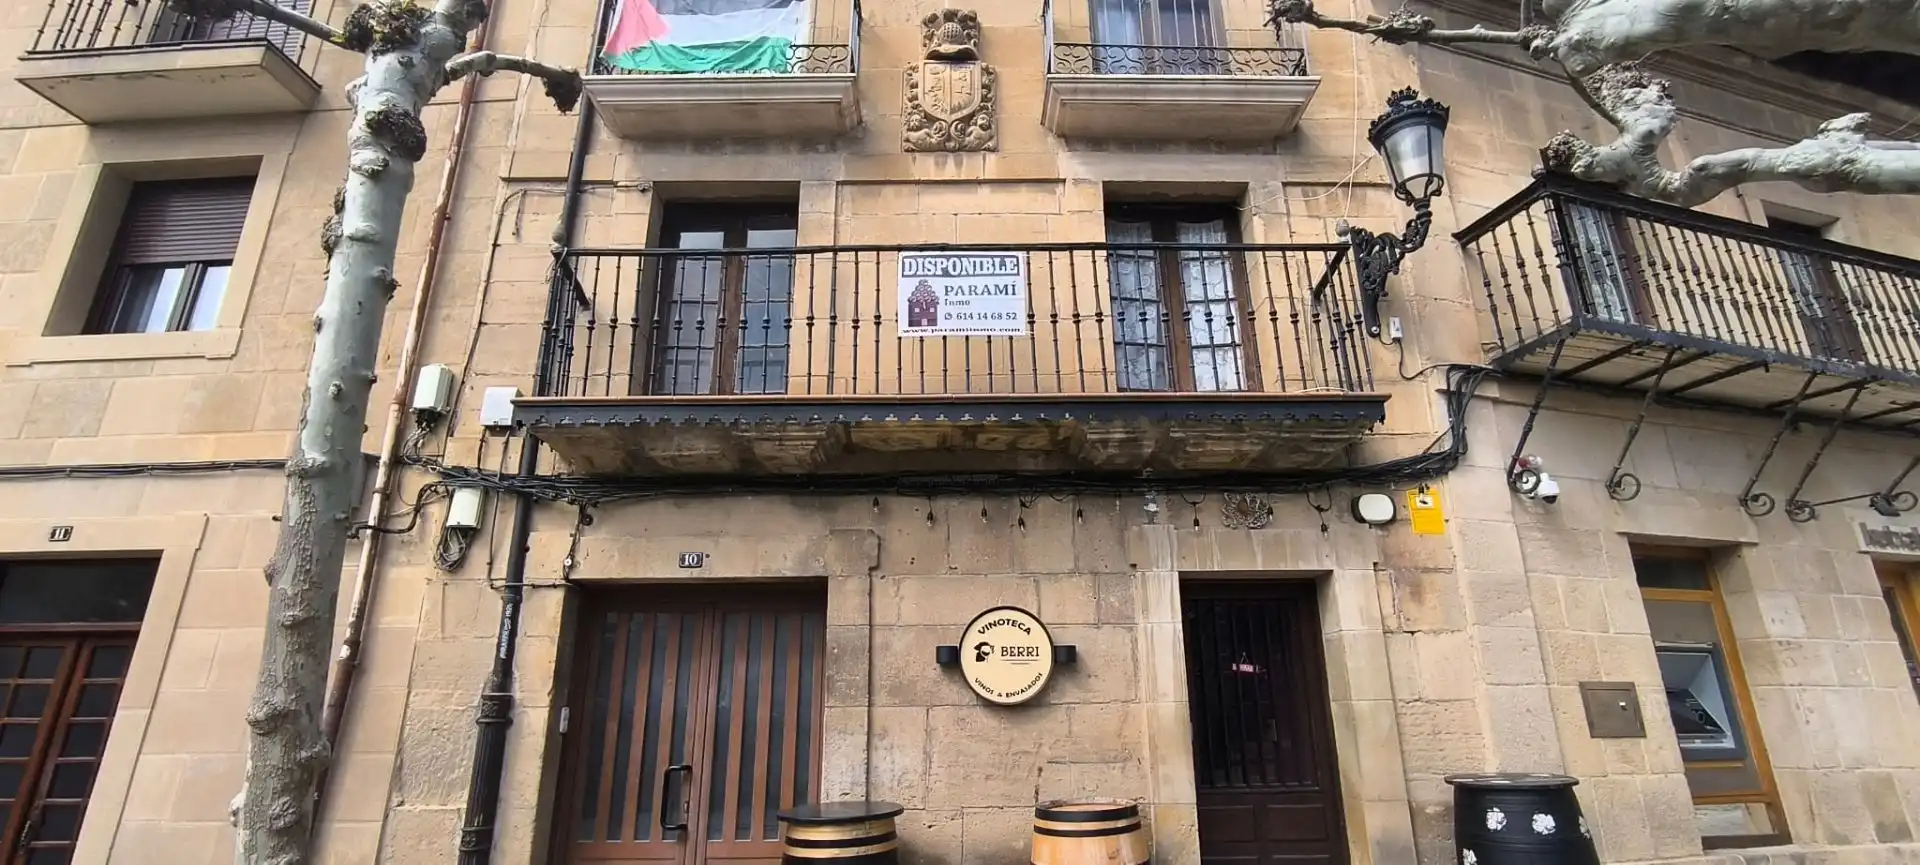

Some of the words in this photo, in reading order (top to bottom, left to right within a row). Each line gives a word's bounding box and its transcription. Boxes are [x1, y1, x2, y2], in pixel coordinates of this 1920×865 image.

[903, 257, 1018, 276] DISPONIBLE
[944, 281, 1017, 296] PARAMÍ
[944, 298, 970, 306] Inmo
[956, 312, 974, 320] 614
[978, 312, 988, 320] 14
[991, 312, 1003, 320] 68
[1005, 312, 1017, 320] 52
[685, 553, 697, 565] 10
[978, 618, 1031, 635] VINOTECA
[1001, 646, 1039, 657] BERRI
[974, 678, 994, 695] VINOS
[1005, 672, 1043, 698] ENVASADOS
